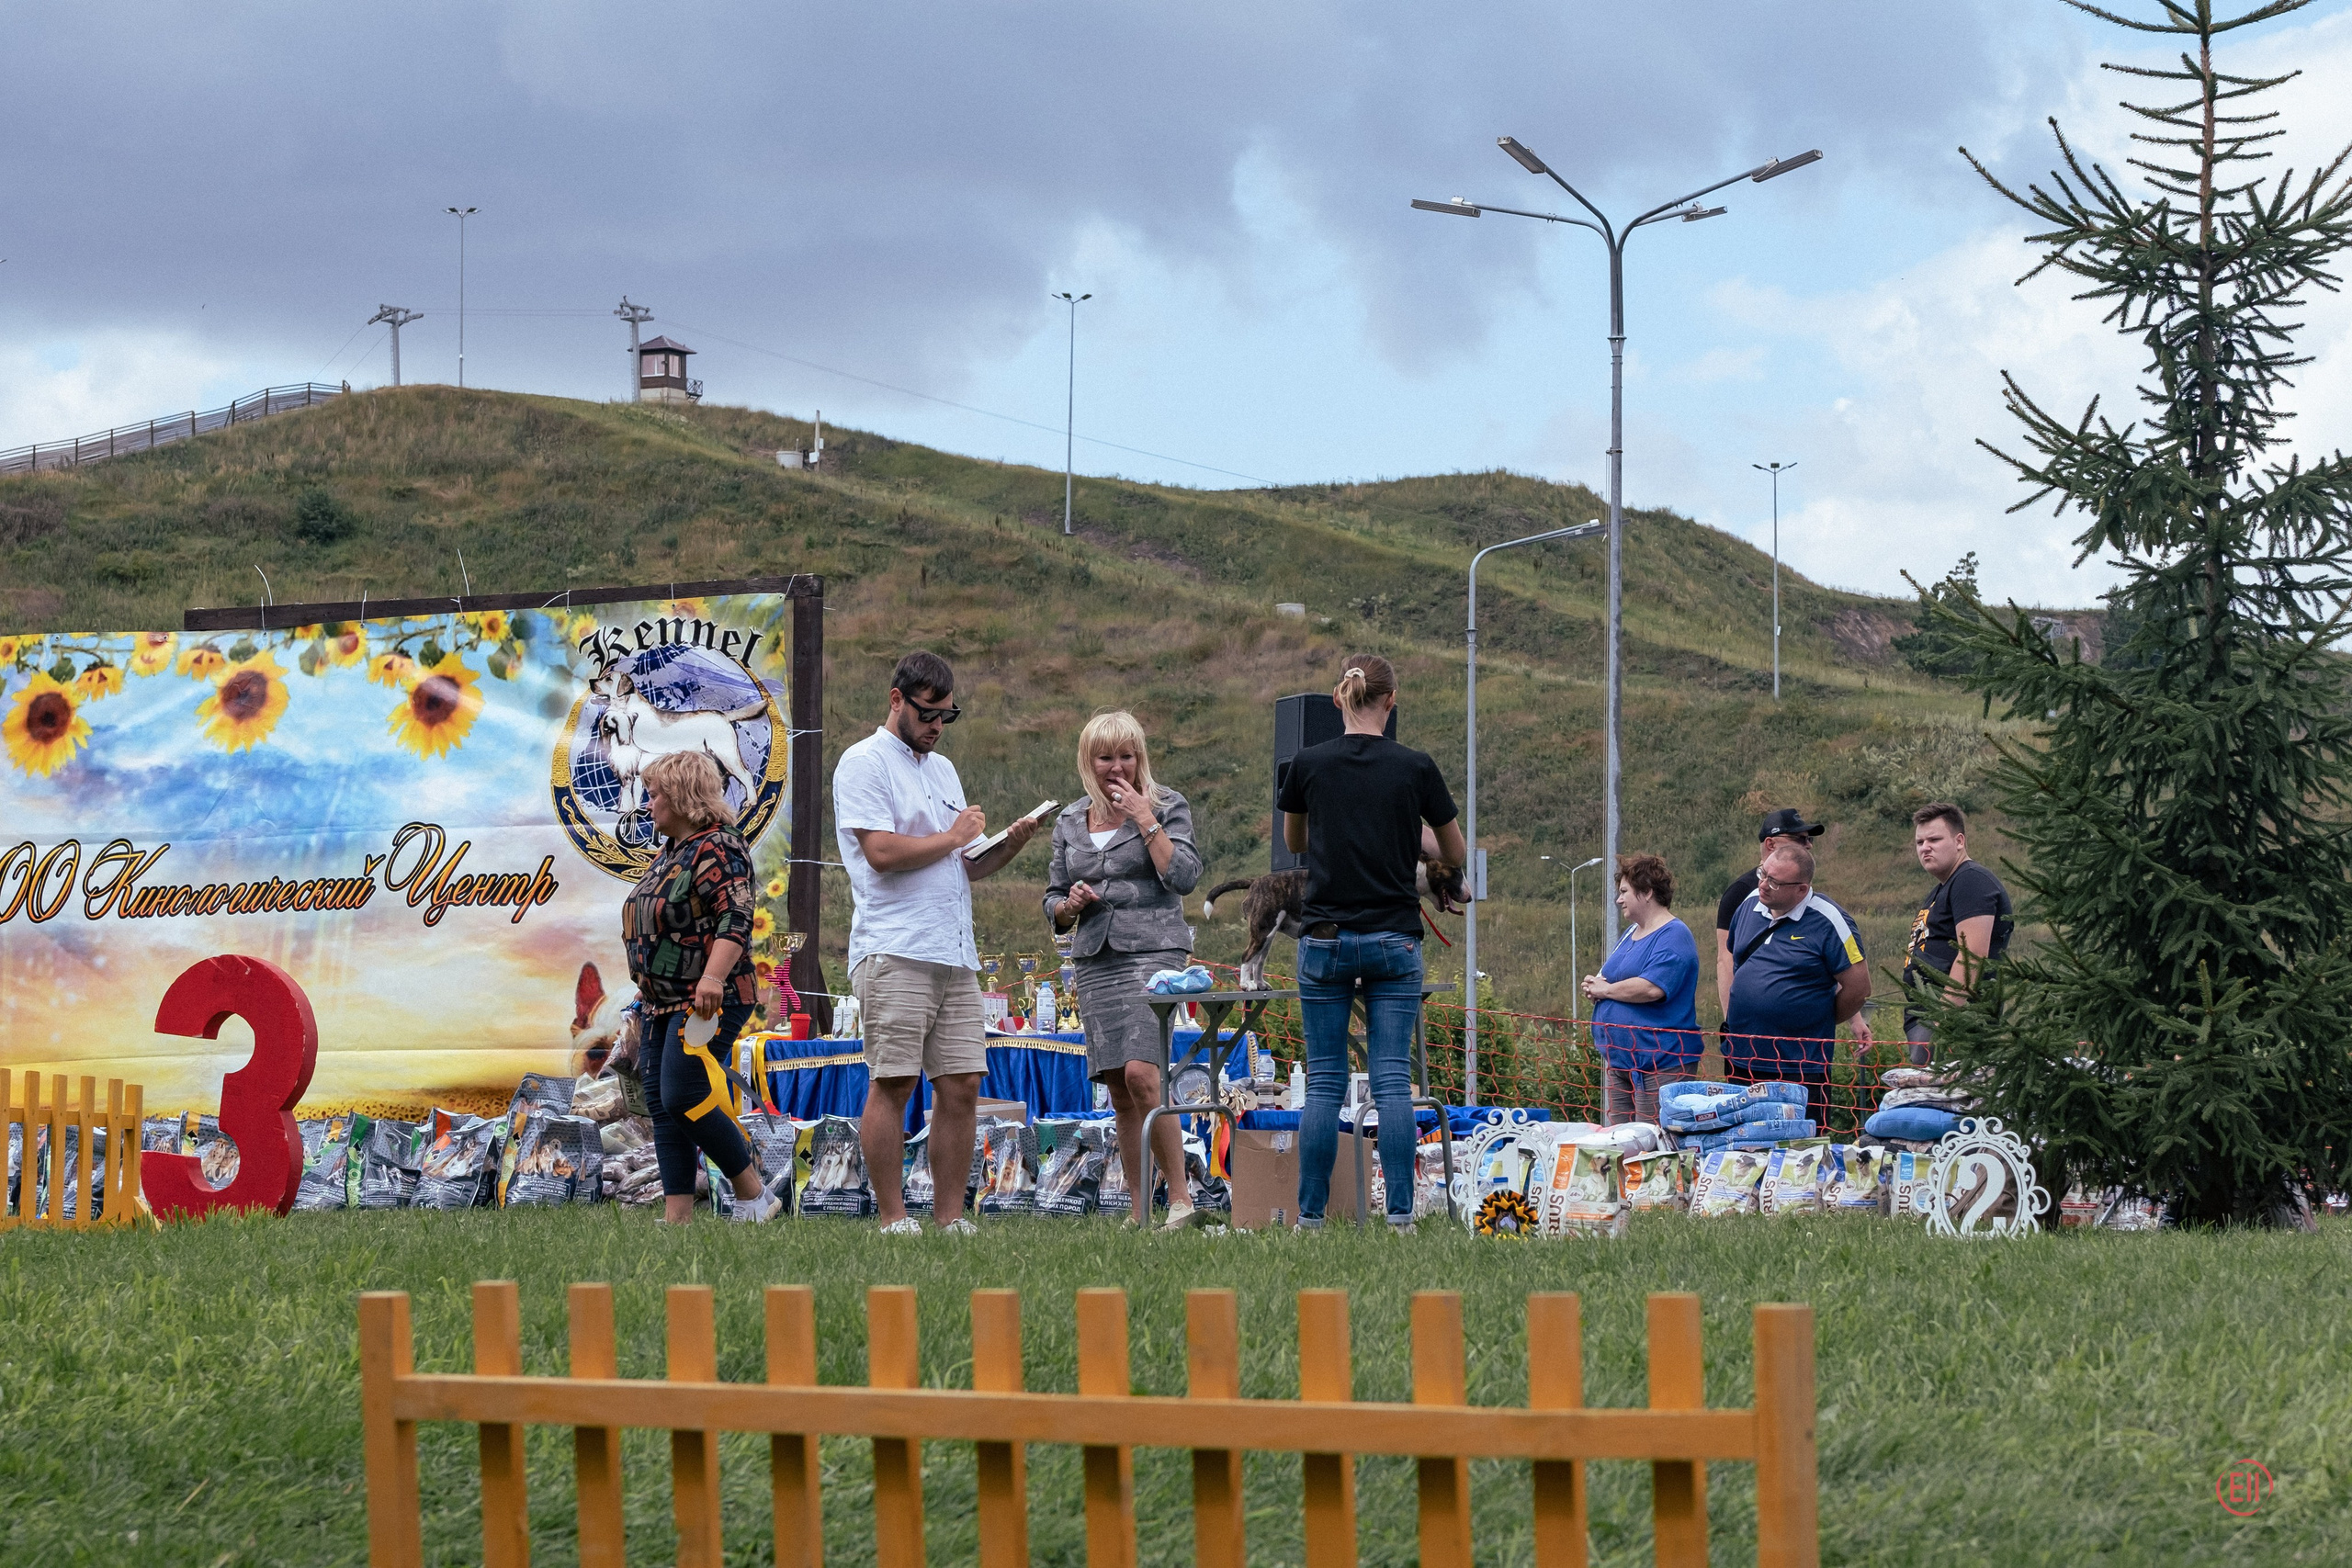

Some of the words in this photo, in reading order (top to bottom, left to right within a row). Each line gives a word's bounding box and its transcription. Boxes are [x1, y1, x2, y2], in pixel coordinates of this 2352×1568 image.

[579, 616, 764, 673] Kennel
[84, 838, 385, 919] Кинологический
[385, 822, 559, 927] Центр
[141, 954, 318, 1216] 3
[1957, 1153, 2007, 1235] 2
